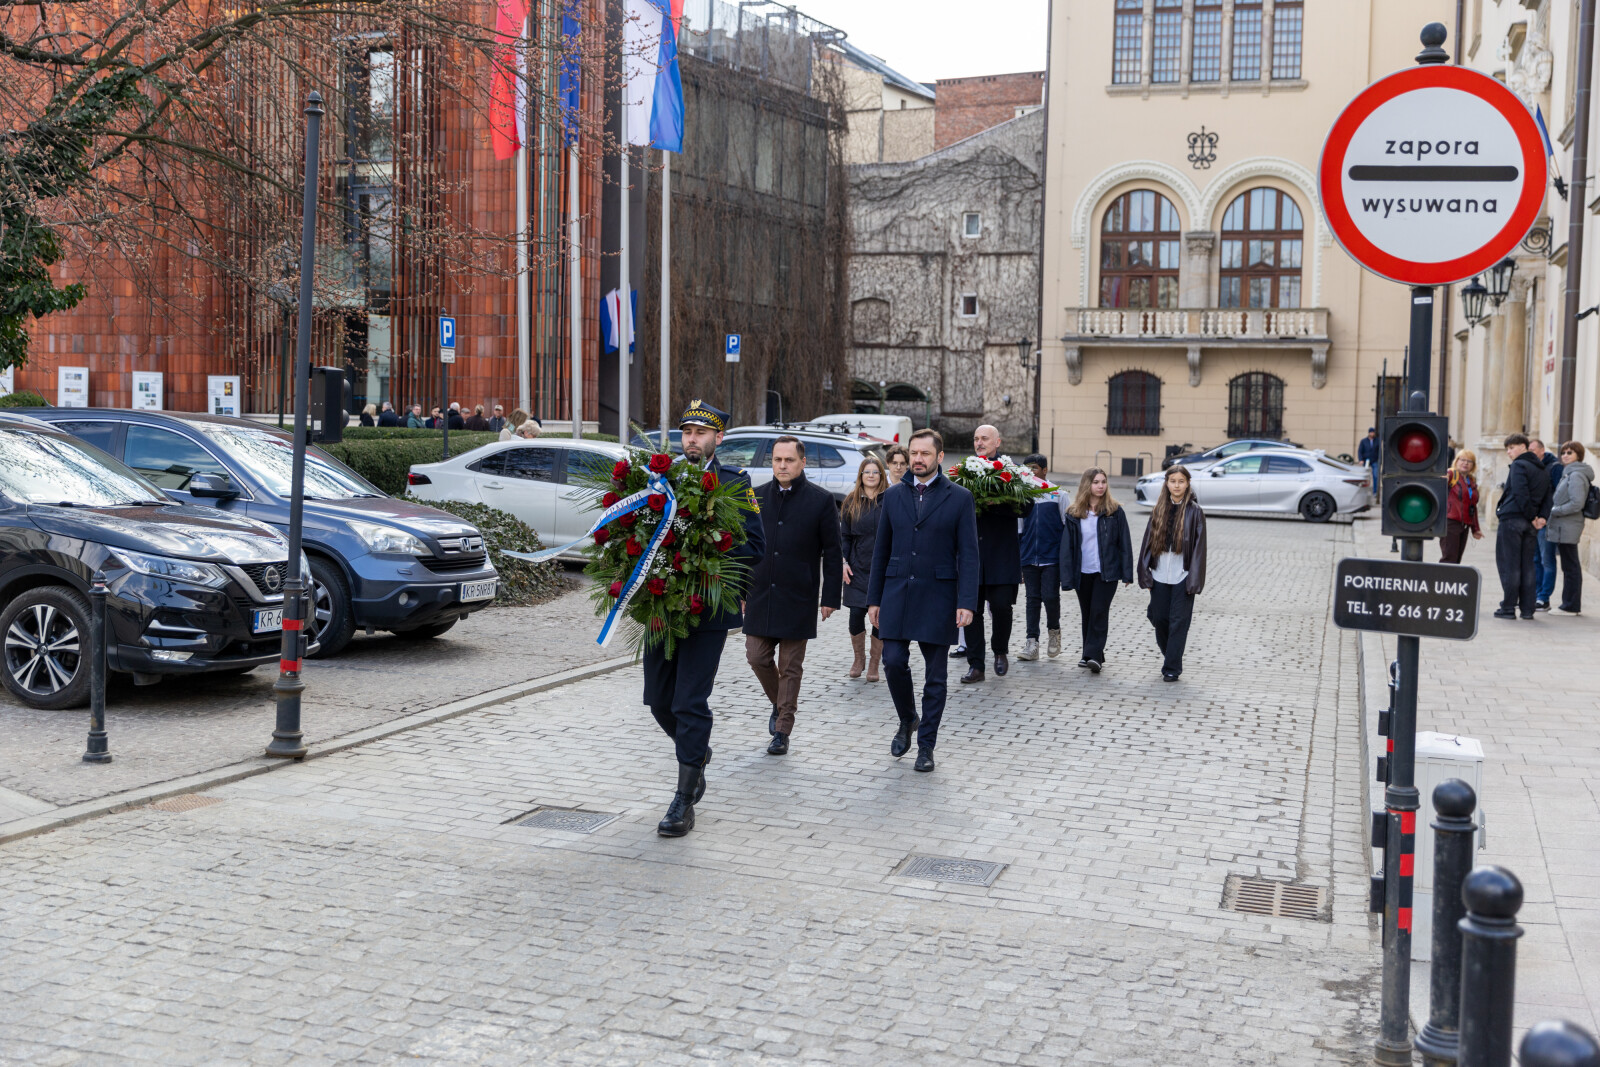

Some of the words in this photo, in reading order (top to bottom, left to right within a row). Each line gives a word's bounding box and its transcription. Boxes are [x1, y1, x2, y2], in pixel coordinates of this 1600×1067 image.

[1385, 140, 1480, 161] zapora
[1361, 198, 1498, 219] wysuwana
[443, 320, 453, 344] P
[729, 336, 738, 349] P
[465, 584, 476, 598] KR
[1344, 575, 1428, 593] PORTIERNIA
[1434, 581, 1469, 596] UMK
[260, 611, 274, 628] KR
[1346, 600, 1373, 615] TEL.
[1378, 603, 1393, 617] 12
[1397, 604, 1421, 619] 616
[1426, 606, 1441, 620] 17
[1445, 608, 1464, 622] 32
